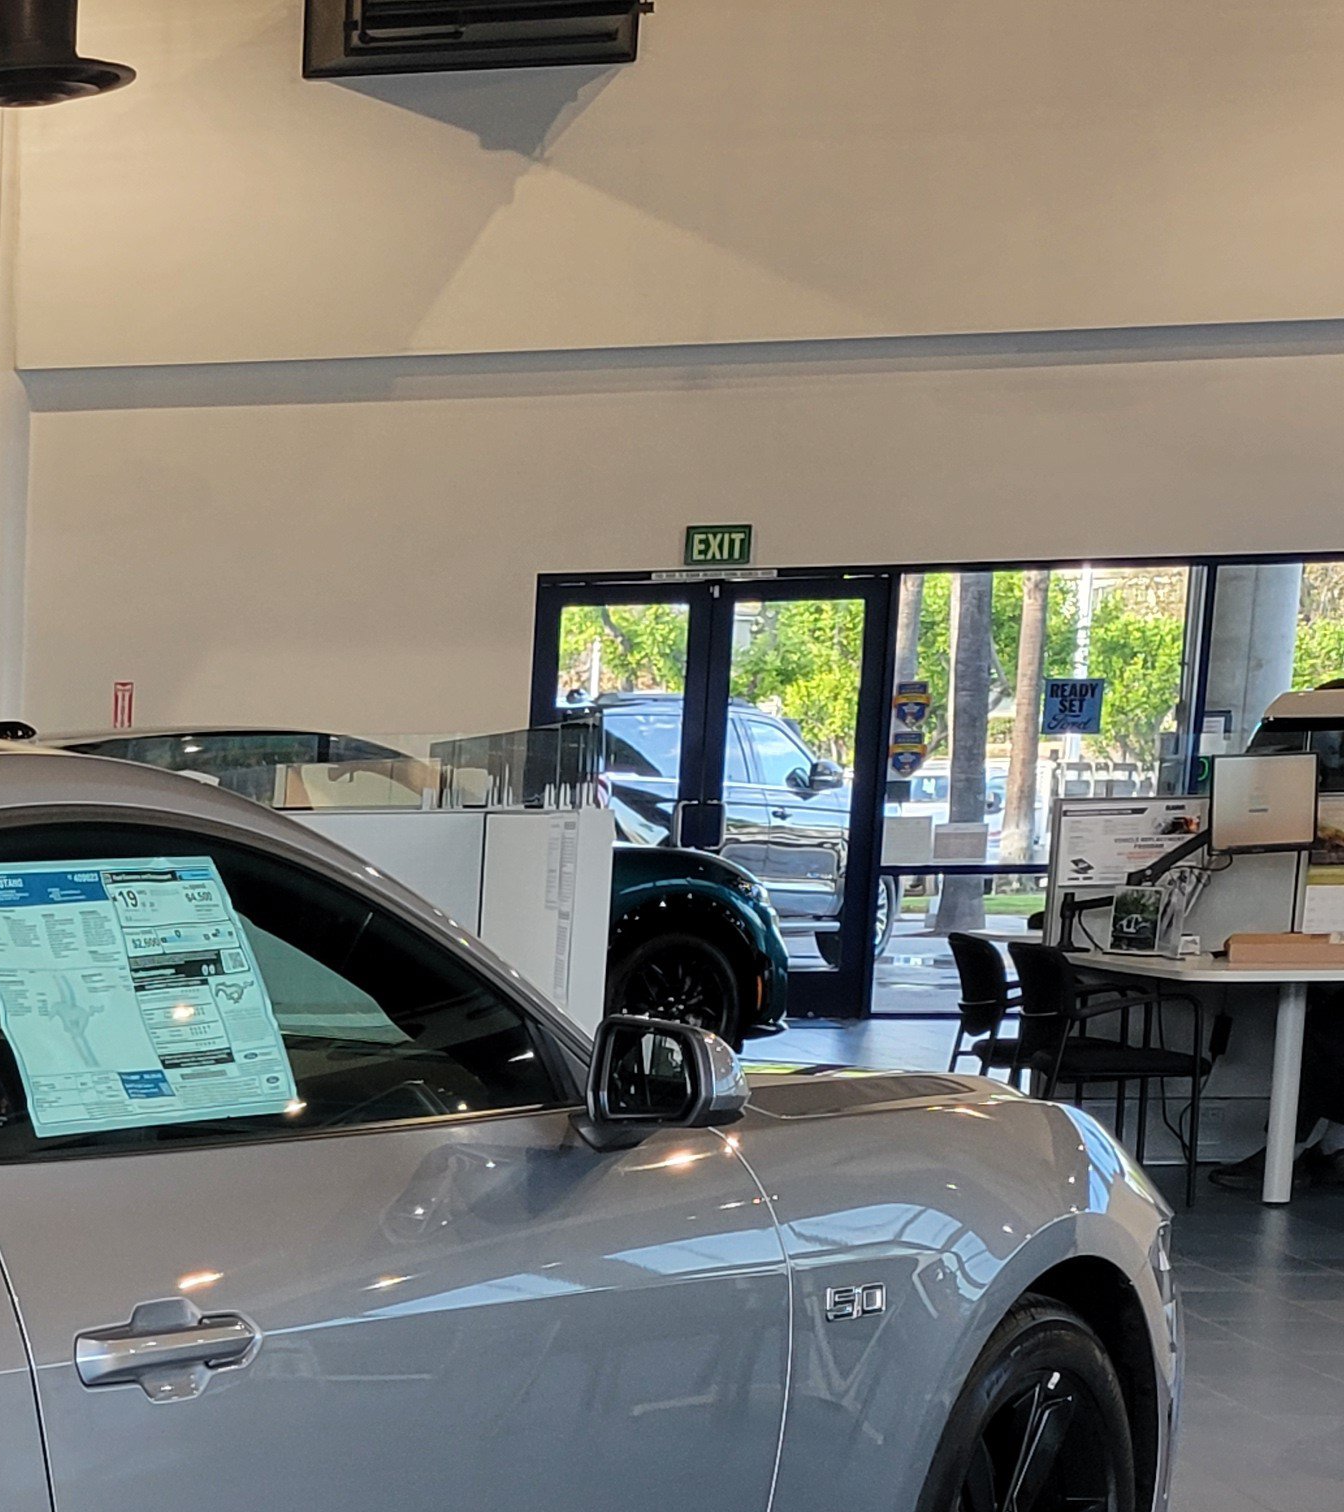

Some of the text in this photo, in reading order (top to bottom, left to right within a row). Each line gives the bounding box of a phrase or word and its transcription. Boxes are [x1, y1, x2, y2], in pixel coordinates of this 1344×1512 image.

[692, 533, 745, 560] EXIT
[1050, 683, 1098, 698] READY
[1059, 698, 1086, 713] SET
[1047, 714, 1092, 730] Ford
[118, 890, 138, 908] 19
